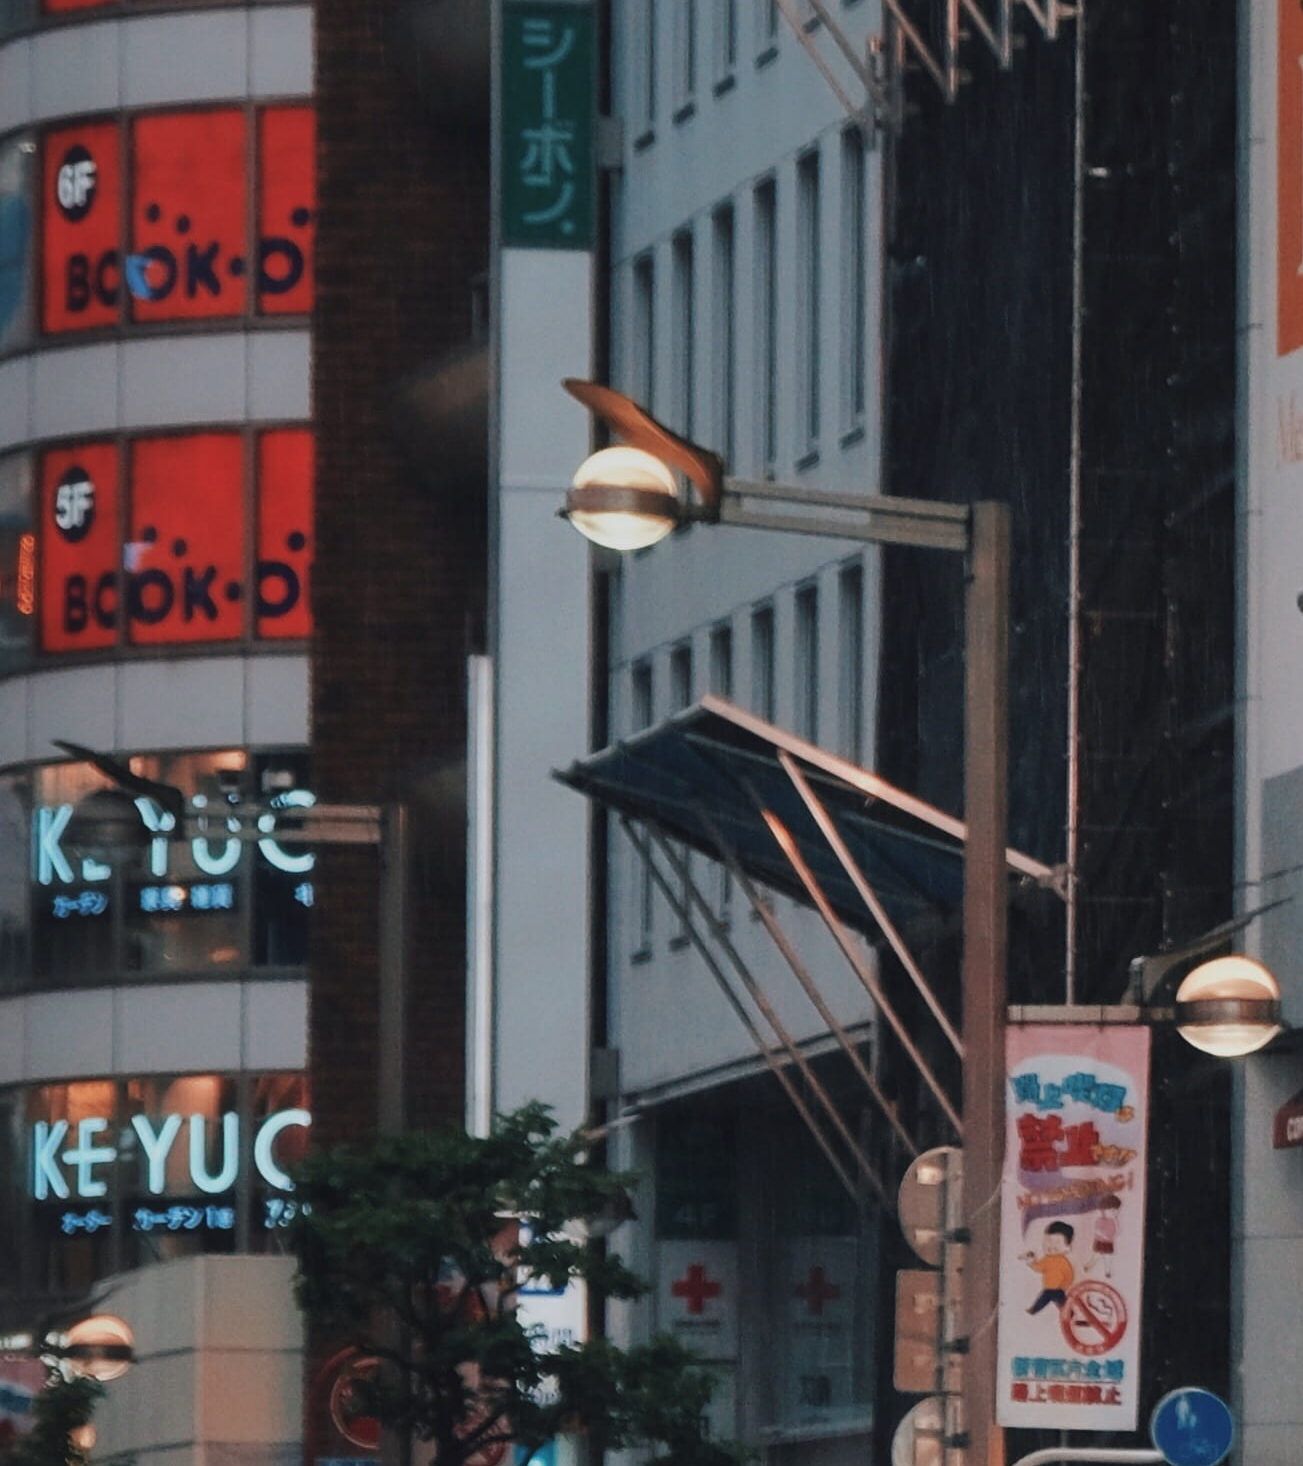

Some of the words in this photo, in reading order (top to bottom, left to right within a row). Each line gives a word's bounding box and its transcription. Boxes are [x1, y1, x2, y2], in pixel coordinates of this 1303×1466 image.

[58, 158, 96, 212] 6F
[56, 477, 94, 532] 5F
[38, 790, 316, 885] KYUC
